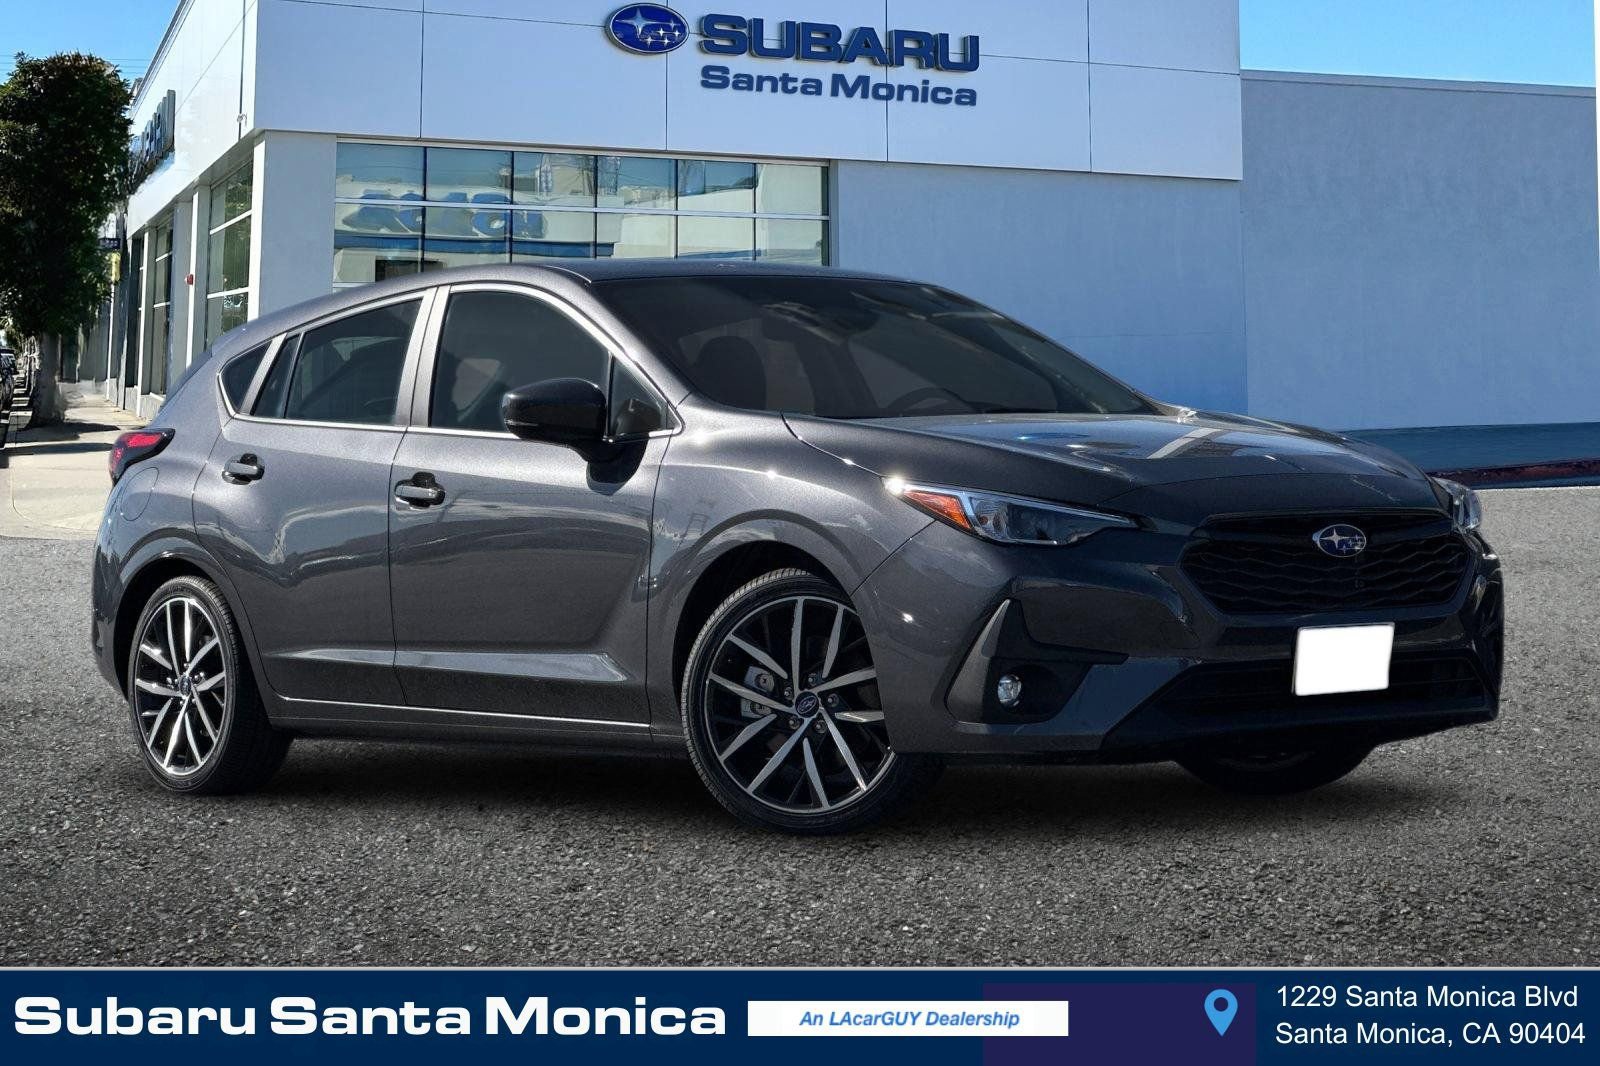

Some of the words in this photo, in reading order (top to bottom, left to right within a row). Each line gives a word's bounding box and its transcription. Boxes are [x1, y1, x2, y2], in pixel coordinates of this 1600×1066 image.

[700, 13, 980, 73] SUBARU
[700, 65, 822, 97] Santa
[830, 73, 977, 106] Monica
